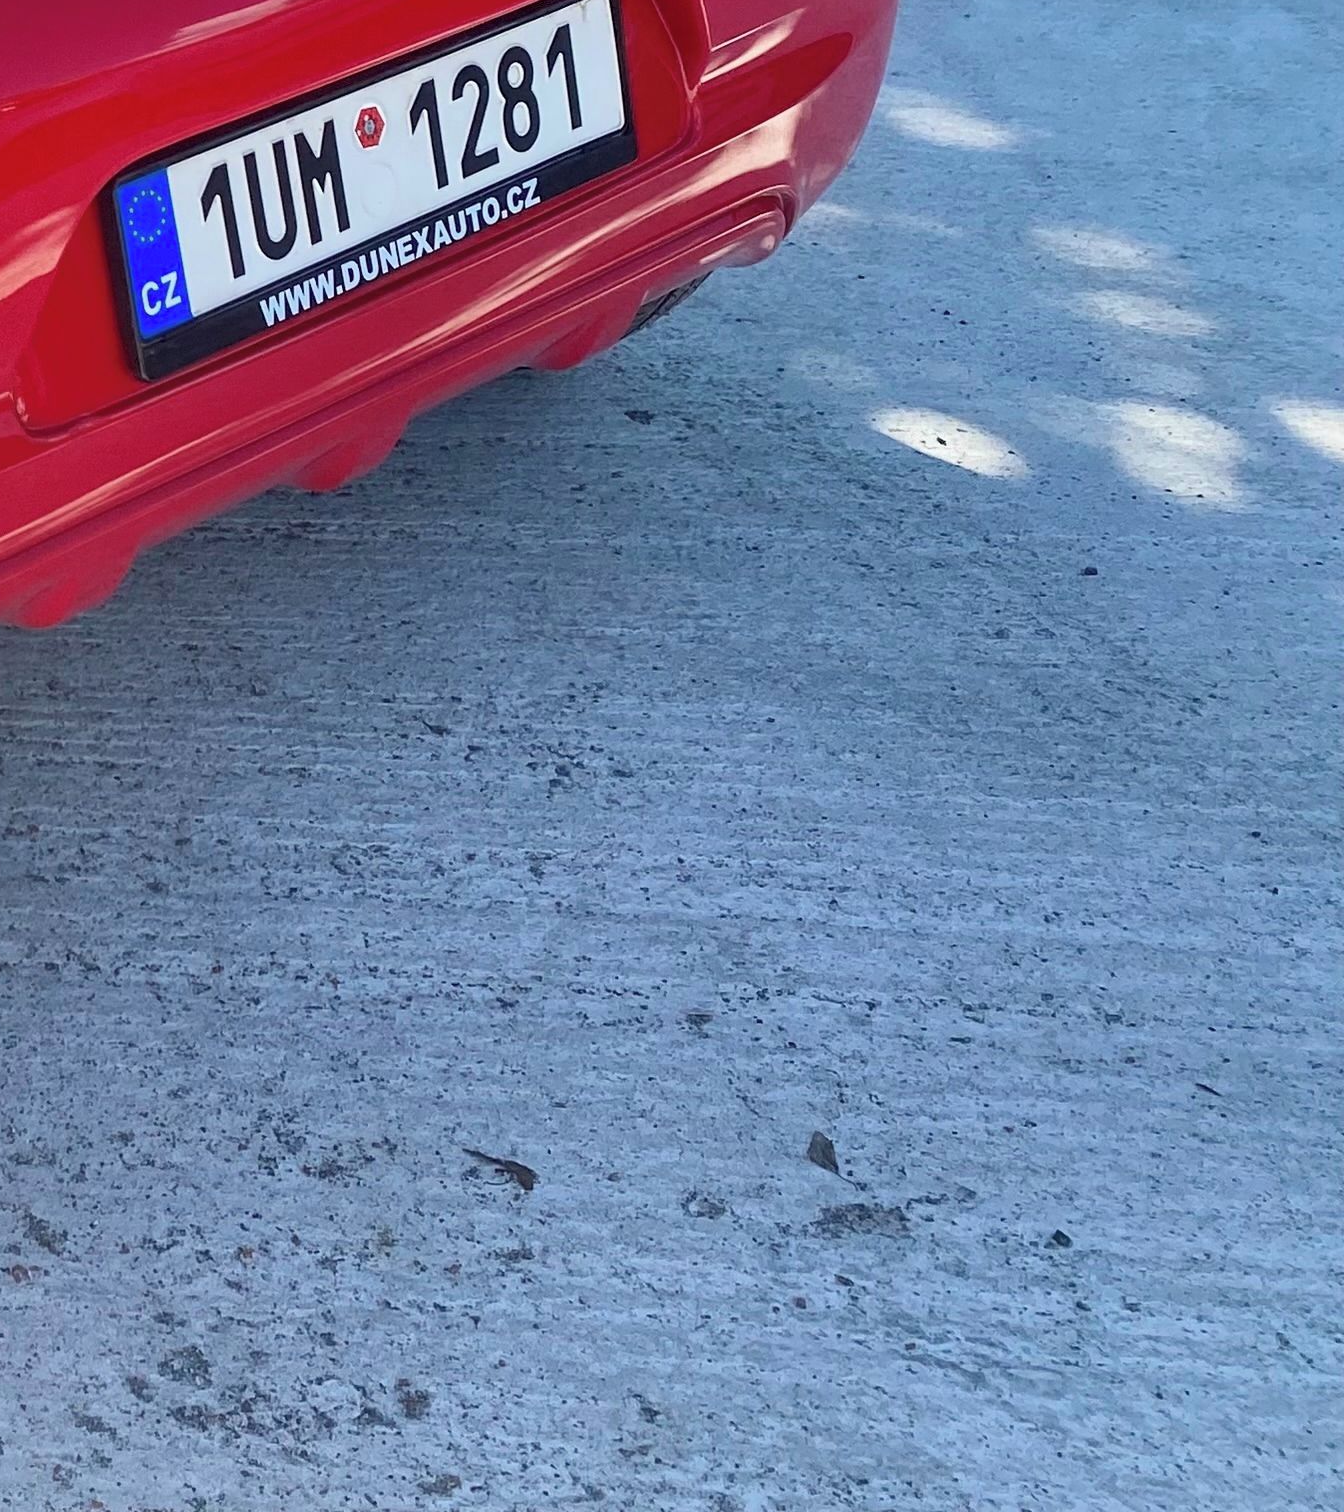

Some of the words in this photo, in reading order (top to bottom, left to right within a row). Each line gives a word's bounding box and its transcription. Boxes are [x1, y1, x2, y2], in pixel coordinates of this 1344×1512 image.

[199, 119, 351, 279] 1UM
[411, 23, 583, 190] 1281
[141, 270, 182, 317] CZ
[258, 177, 542, 328] WWW.DUNEXAUTO.CZ
